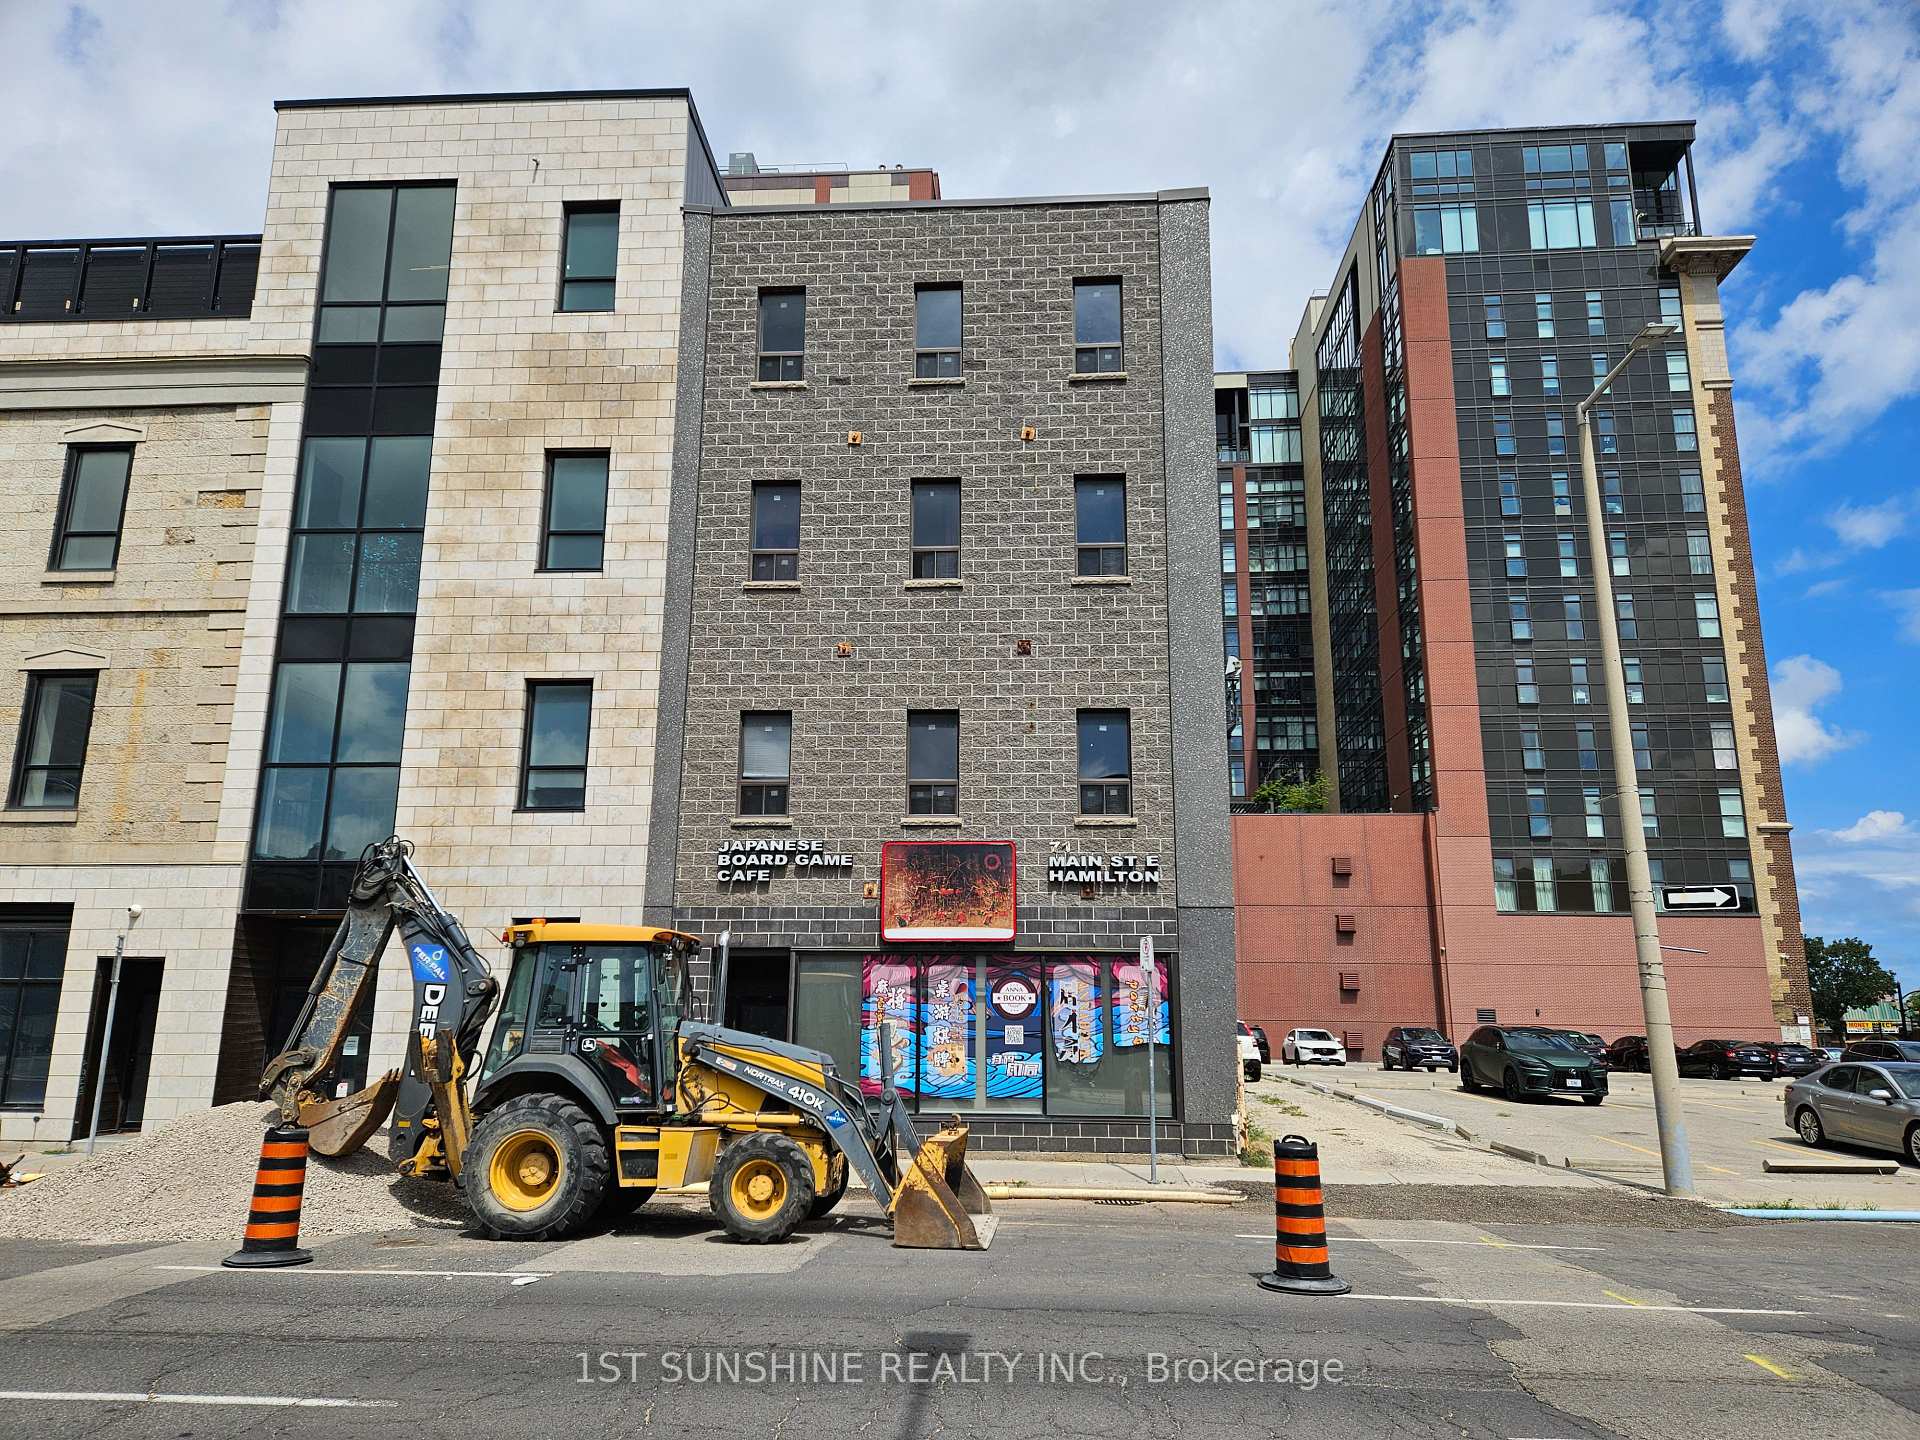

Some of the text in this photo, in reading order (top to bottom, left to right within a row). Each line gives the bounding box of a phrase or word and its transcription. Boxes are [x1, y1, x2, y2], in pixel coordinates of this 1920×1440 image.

[718, 840, 824, 852] JAPANESE
[717, 854, 853, 866] BOARD GAME
[1049, 855, 1159, 867] MAIN ST E
[717, 869, 771, 882] CAFE
[1049, 870, 1160, 882] HAMILTON
[1003, 994, 1027, 1002] BOOK
[743, 1065, 787, 1090] NORTRAX
[787, 1086, 827, 1112] 410K
